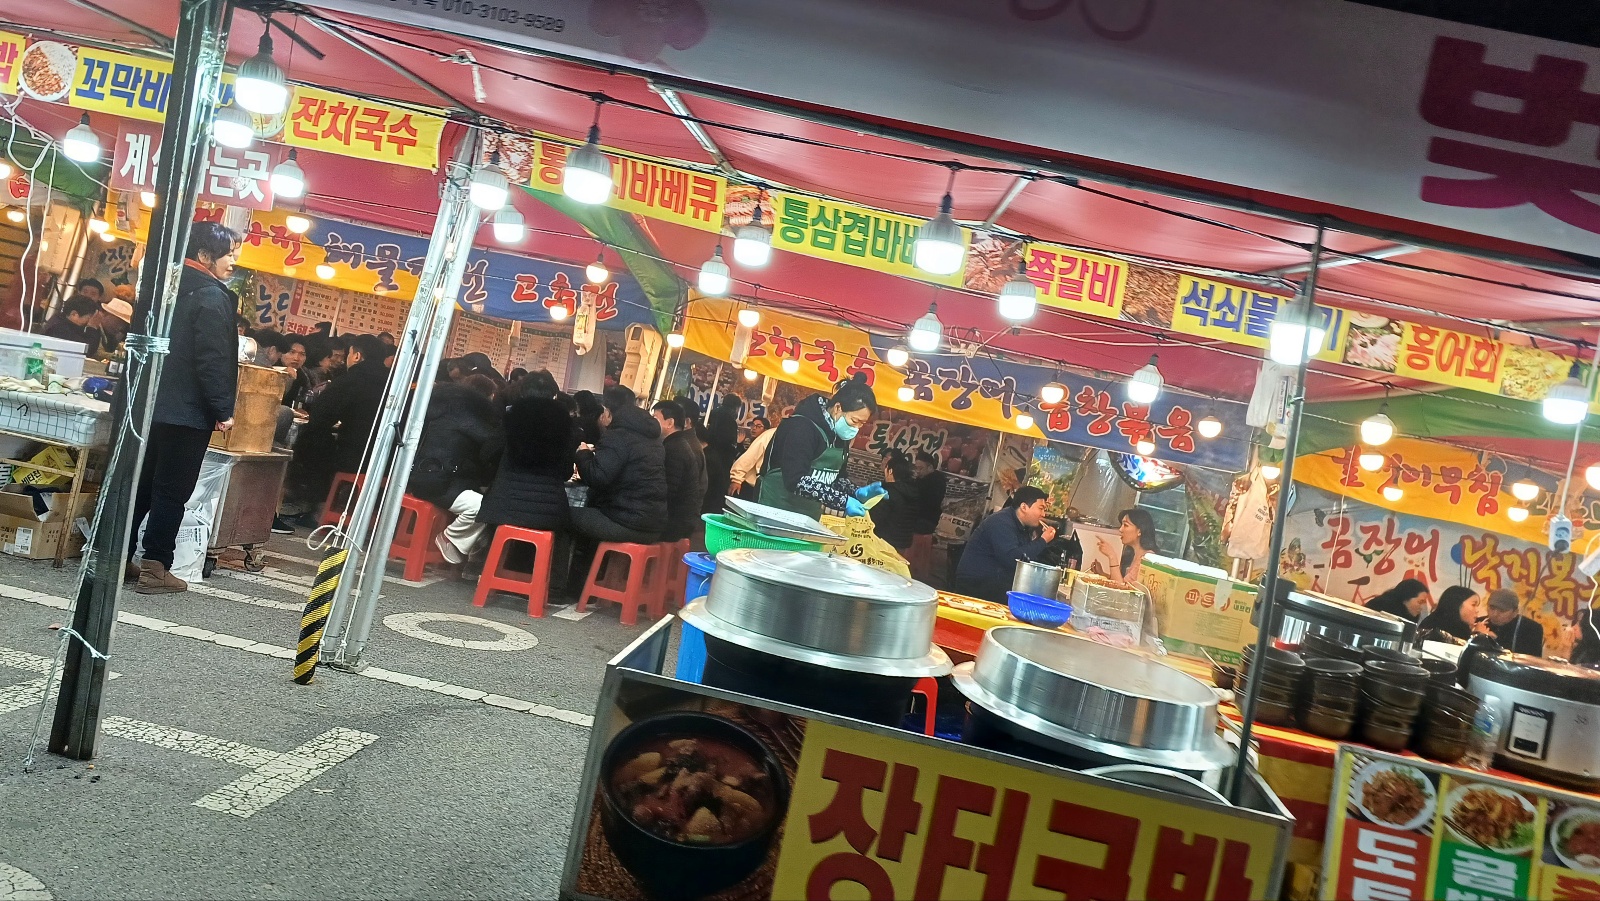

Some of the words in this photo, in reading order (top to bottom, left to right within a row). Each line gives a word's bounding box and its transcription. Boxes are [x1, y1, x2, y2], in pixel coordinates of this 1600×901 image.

[291, 96, 418, 155] 잔치국수
[119, 132, 270, 203] 계는곳
[538, 140, 718, 222] 통바베큐
[1026, 249, 1121, 308] 쪽갈비
[1406, 324, 1503, 383] 홍어회
[1321, 516, 1441, 583] 곰장어
